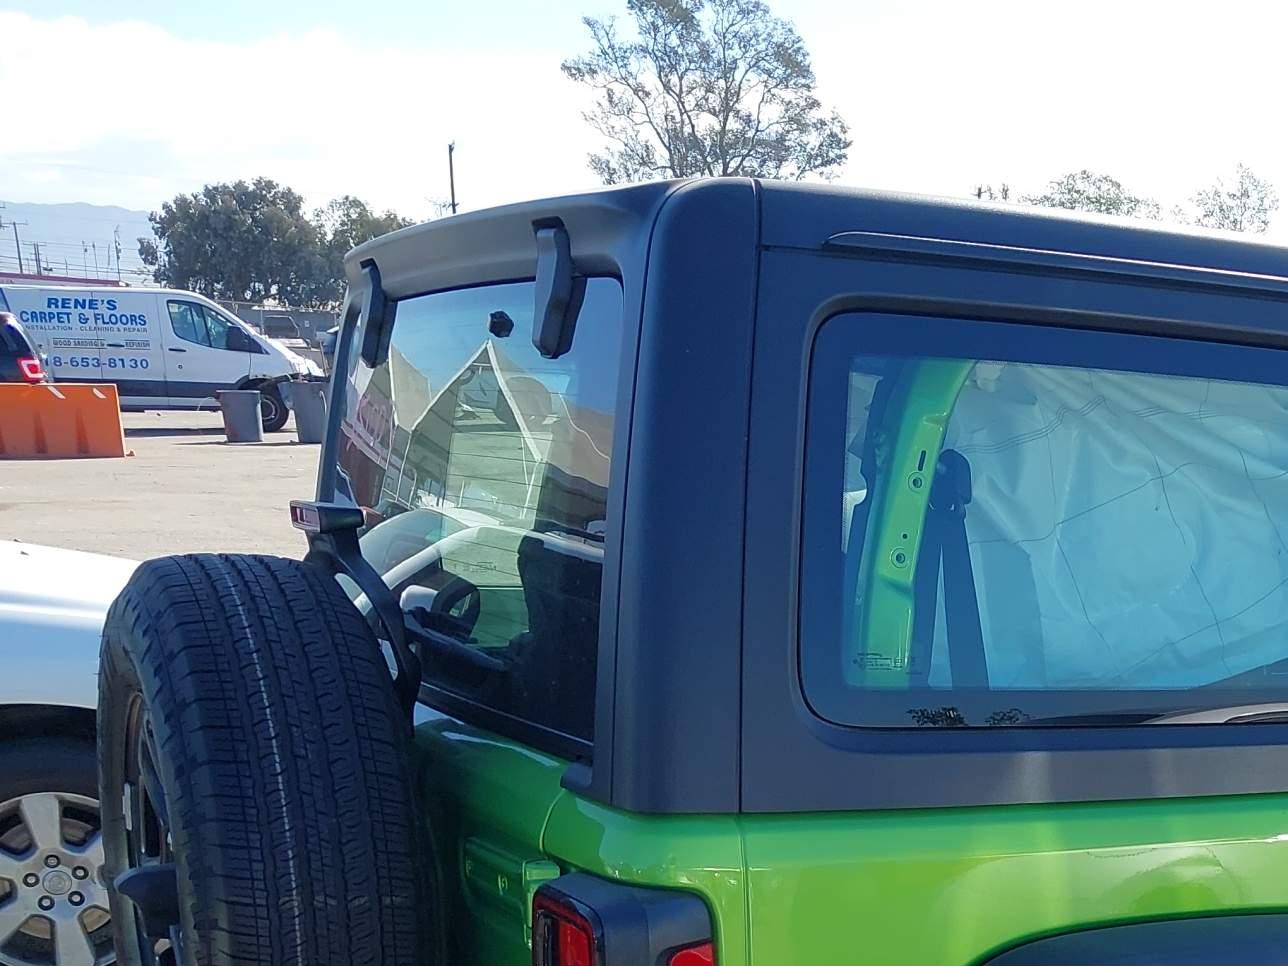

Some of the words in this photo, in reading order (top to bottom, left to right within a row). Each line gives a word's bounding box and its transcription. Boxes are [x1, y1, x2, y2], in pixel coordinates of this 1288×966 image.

[47, 297, 117, 310] RENE'S
[19, 311, 73, 324] CARPET
[78, 312, 90, 325] &
[94, 313, 148, 327] FLOORS
[44, 356, 149, 368] 18-653-8130
